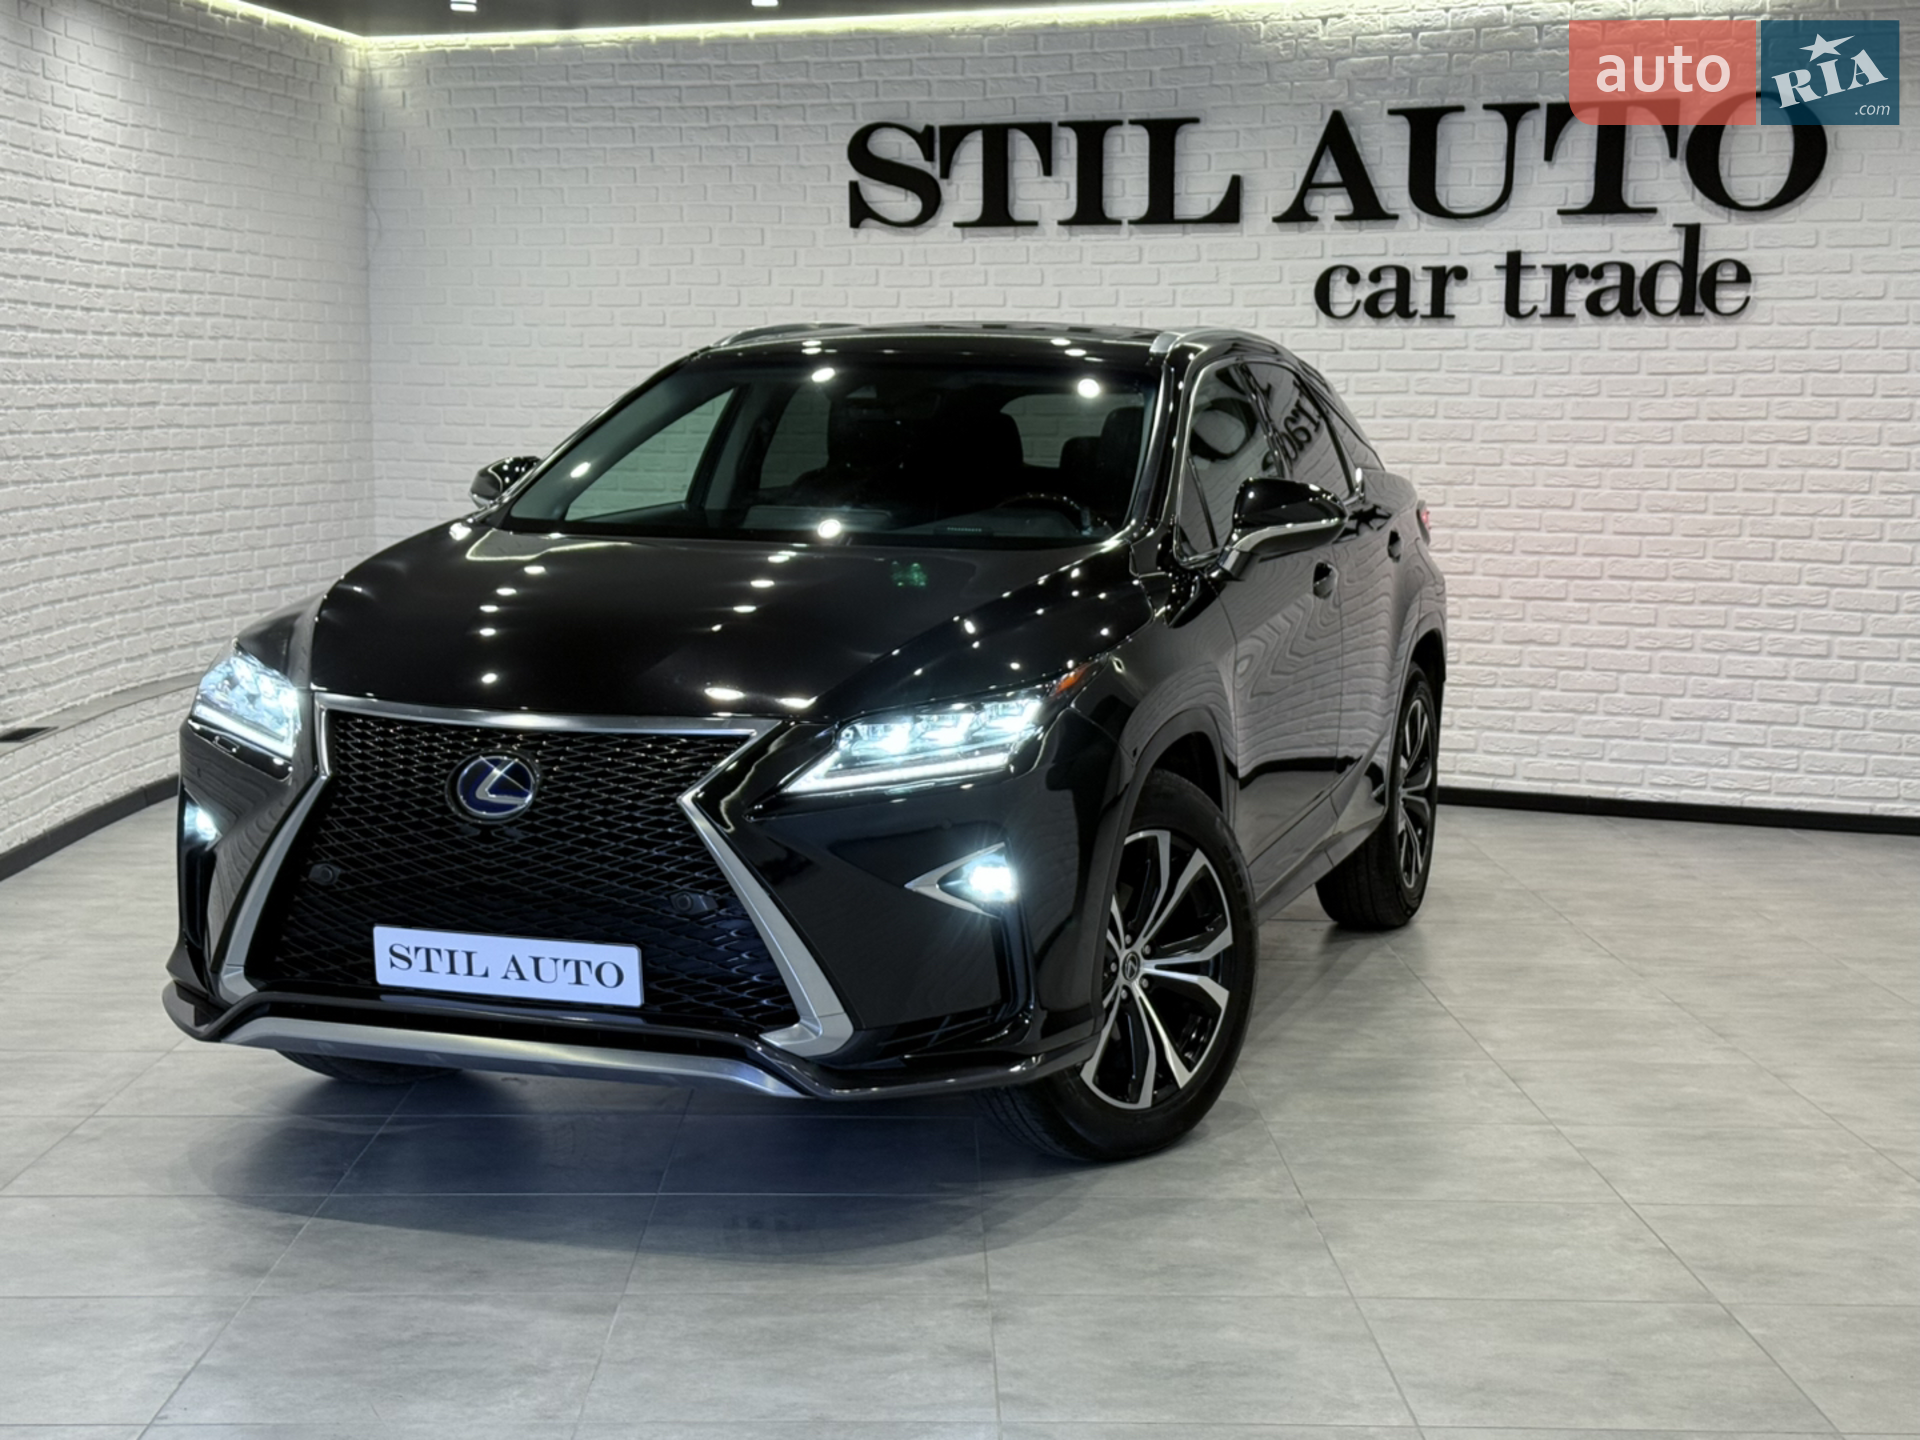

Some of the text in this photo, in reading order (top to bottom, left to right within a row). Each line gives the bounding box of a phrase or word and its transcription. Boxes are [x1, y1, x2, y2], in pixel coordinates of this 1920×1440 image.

[847, 91, 1828, 229] STIL AUTO
[1314, 224, 1752, 319] car trade
[388, 943, 625, 989] STIL AUTO
